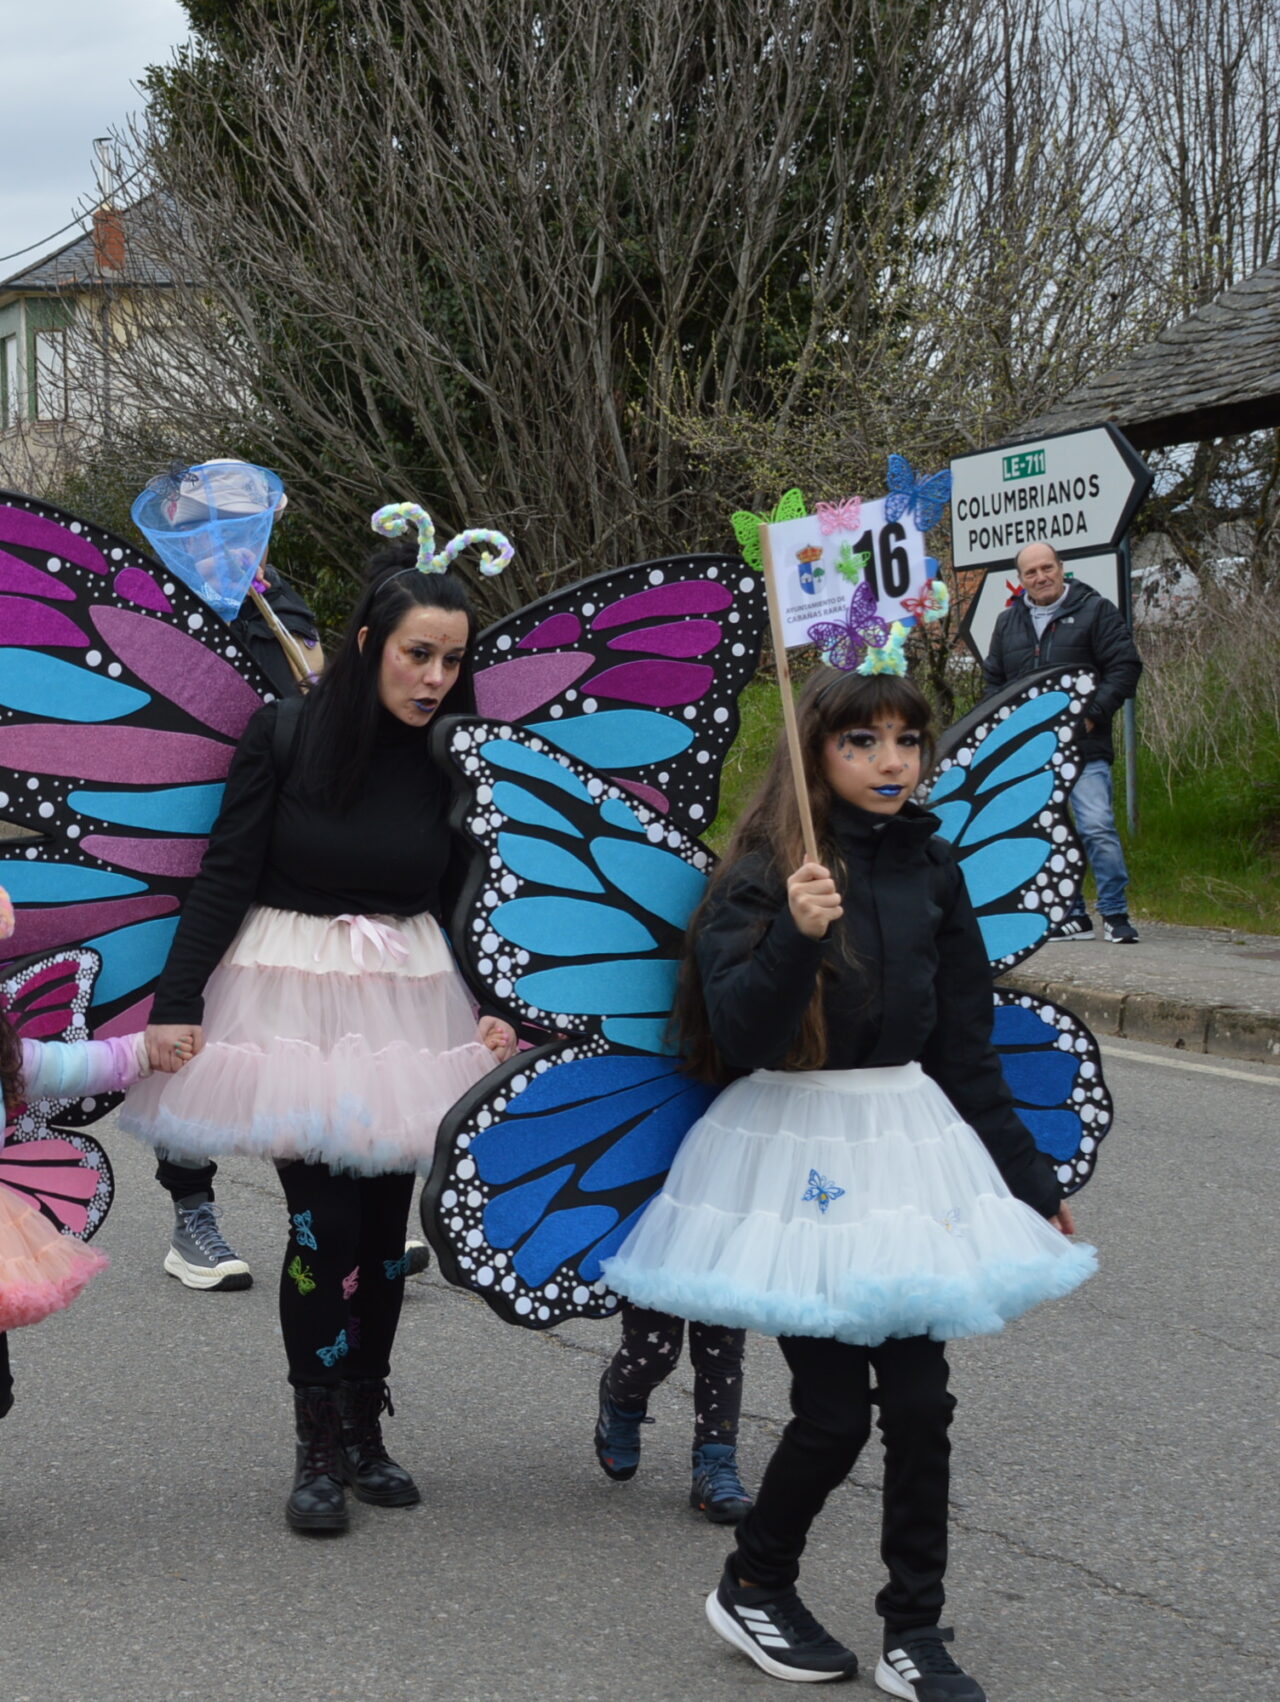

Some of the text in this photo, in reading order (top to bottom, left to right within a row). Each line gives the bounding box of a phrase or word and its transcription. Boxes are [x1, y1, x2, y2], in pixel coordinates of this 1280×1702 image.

[1003, 452, 1045, 479] LE-711
[957, 473, 1100, 521] COLUMBRIANOS
[969, 510, 1088, 552] PONFERRADA
[852, 522, 910, 602] 16
